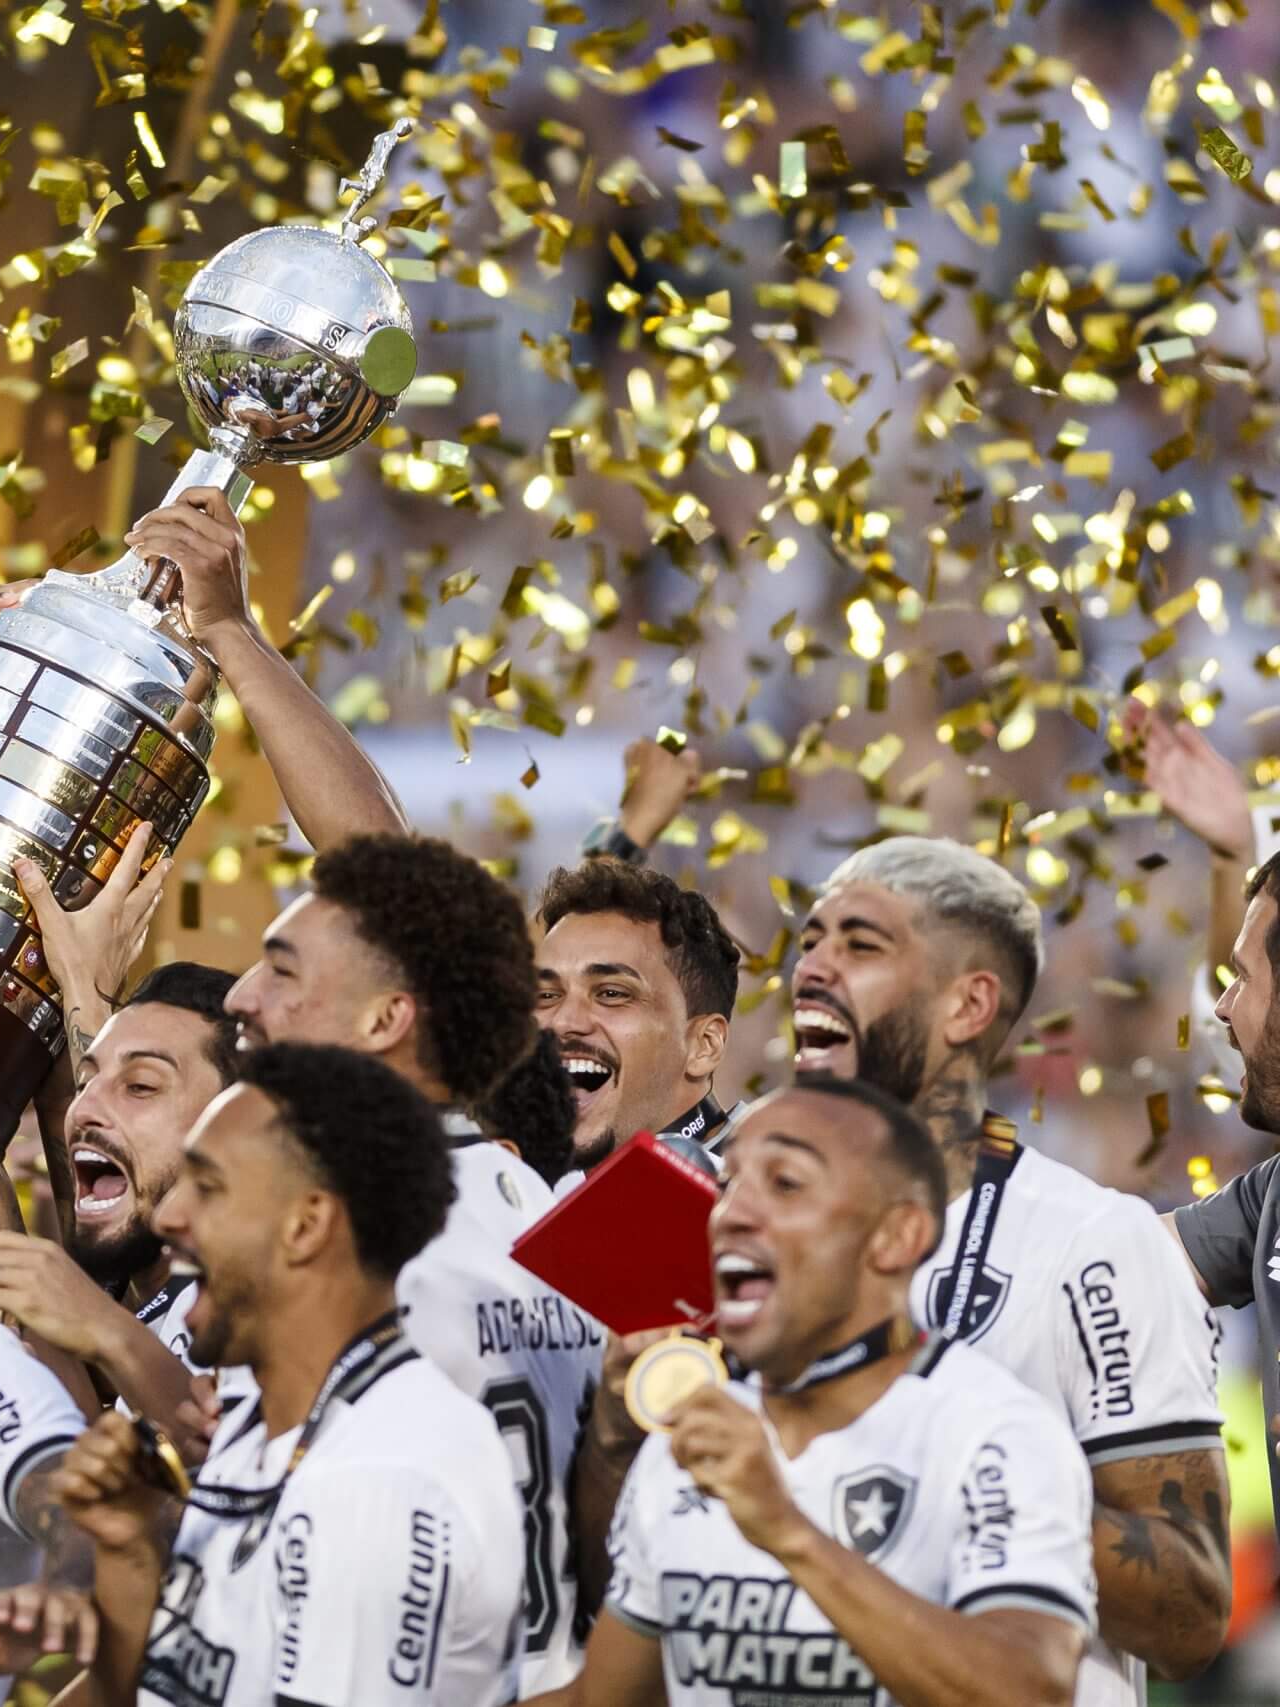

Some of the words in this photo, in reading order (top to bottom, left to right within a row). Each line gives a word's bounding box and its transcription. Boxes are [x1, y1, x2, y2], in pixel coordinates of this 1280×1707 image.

[1080, 1260, 1135, 1418] Centrum
[388, 1509, 436, 1688] Centrum
[661, 1571, 794, 1632] PARI
[665, 1630, 877, 1690] MATCH
